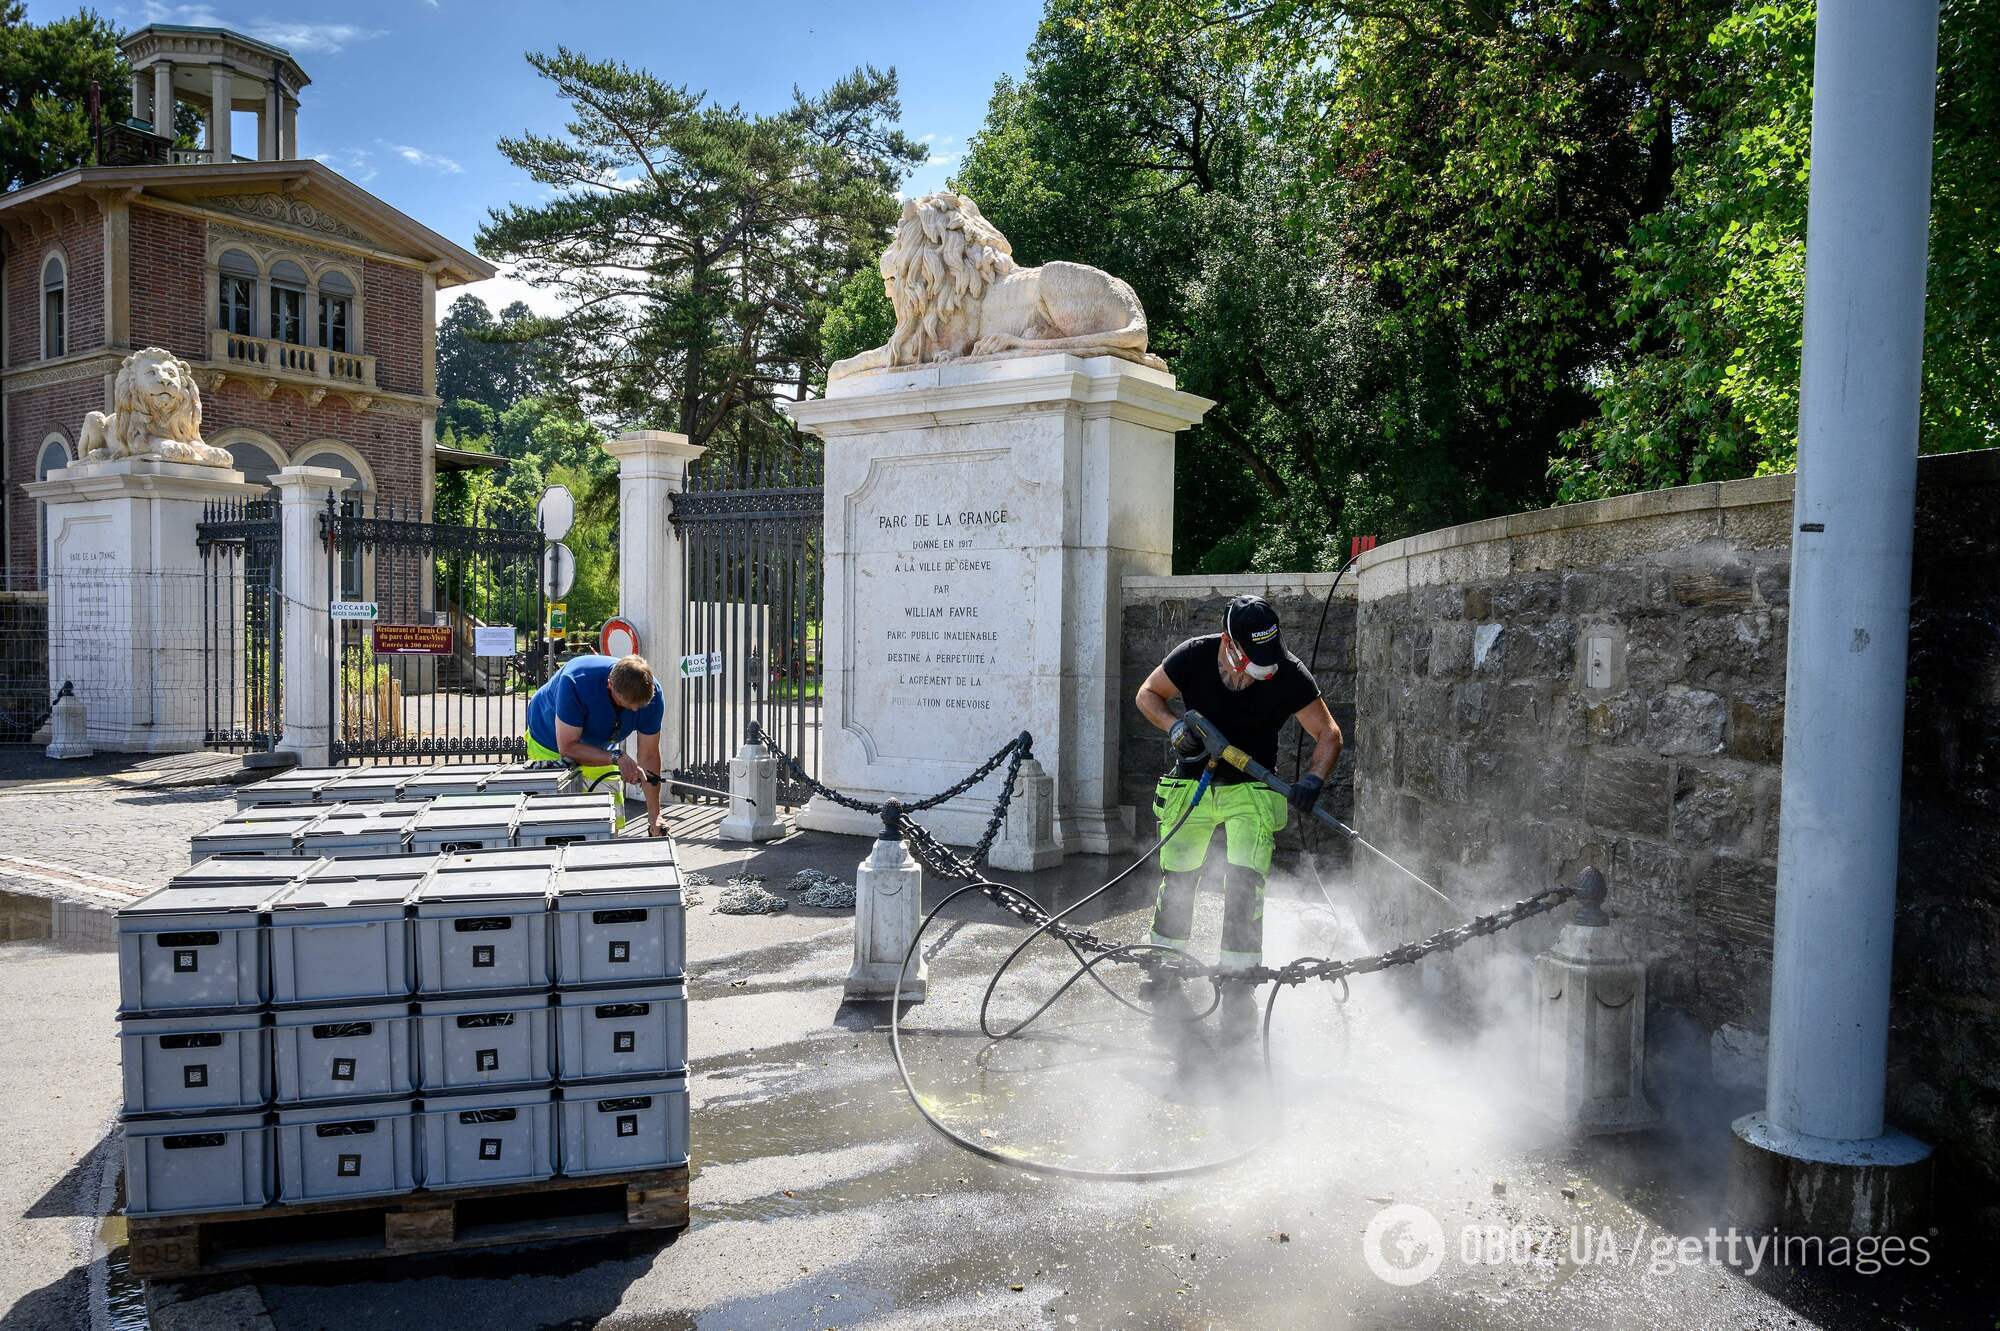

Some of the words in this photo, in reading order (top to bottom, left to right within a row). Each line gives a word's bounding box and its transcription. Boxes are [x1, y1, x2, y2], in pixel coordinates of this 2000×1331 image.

[880, 515, 907, 528] PARC
[915, 514, 929, 527] DE
[937, 513, 952, 526] LA
[959, 510, 1008, 525] GRANGE
[943, 540, 954, 549] EN
[958, 540, 973, 548] 1917
[904, 563, 915, 572] LA
[919, 562, 941, 572] VILLE
[945, 561, 956, 571] DE
[933, 584, 950, 594] PAR
[904, 607, 943, 617] WILLIAM
[949, 606, 979, 617] FAVRE
[887, 631, 907, 640] PARC
[911, 631, 939, 640] PUBLIC
[956, 677, 967, 686] DE
[971, 677, 982, 686] LA
[892, 697, 941, 707] POATION
